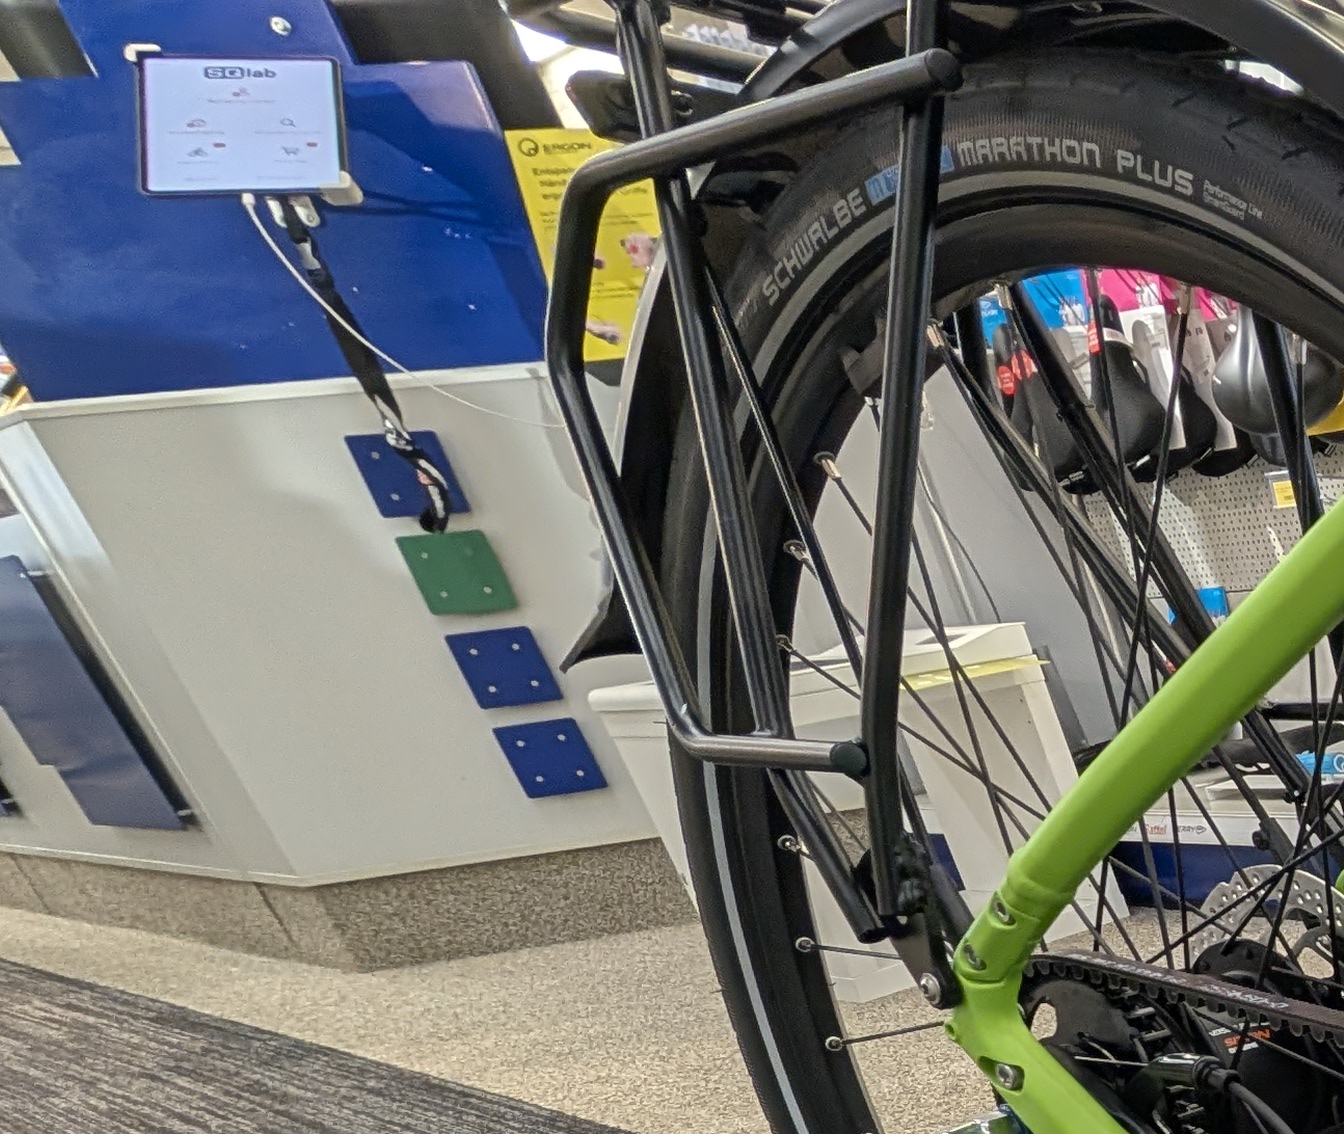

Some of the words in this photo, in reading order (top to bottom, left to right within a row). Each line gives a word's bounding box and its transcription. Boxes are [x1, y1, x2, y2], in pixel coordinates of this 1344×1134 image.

[204, 66, 277, 79] SQlab
[957, 137, 1101, 168] MARATHON
[1117, 149, 1194, 195] PLUS
[762, 188, 867, 306] SCHWALBE
